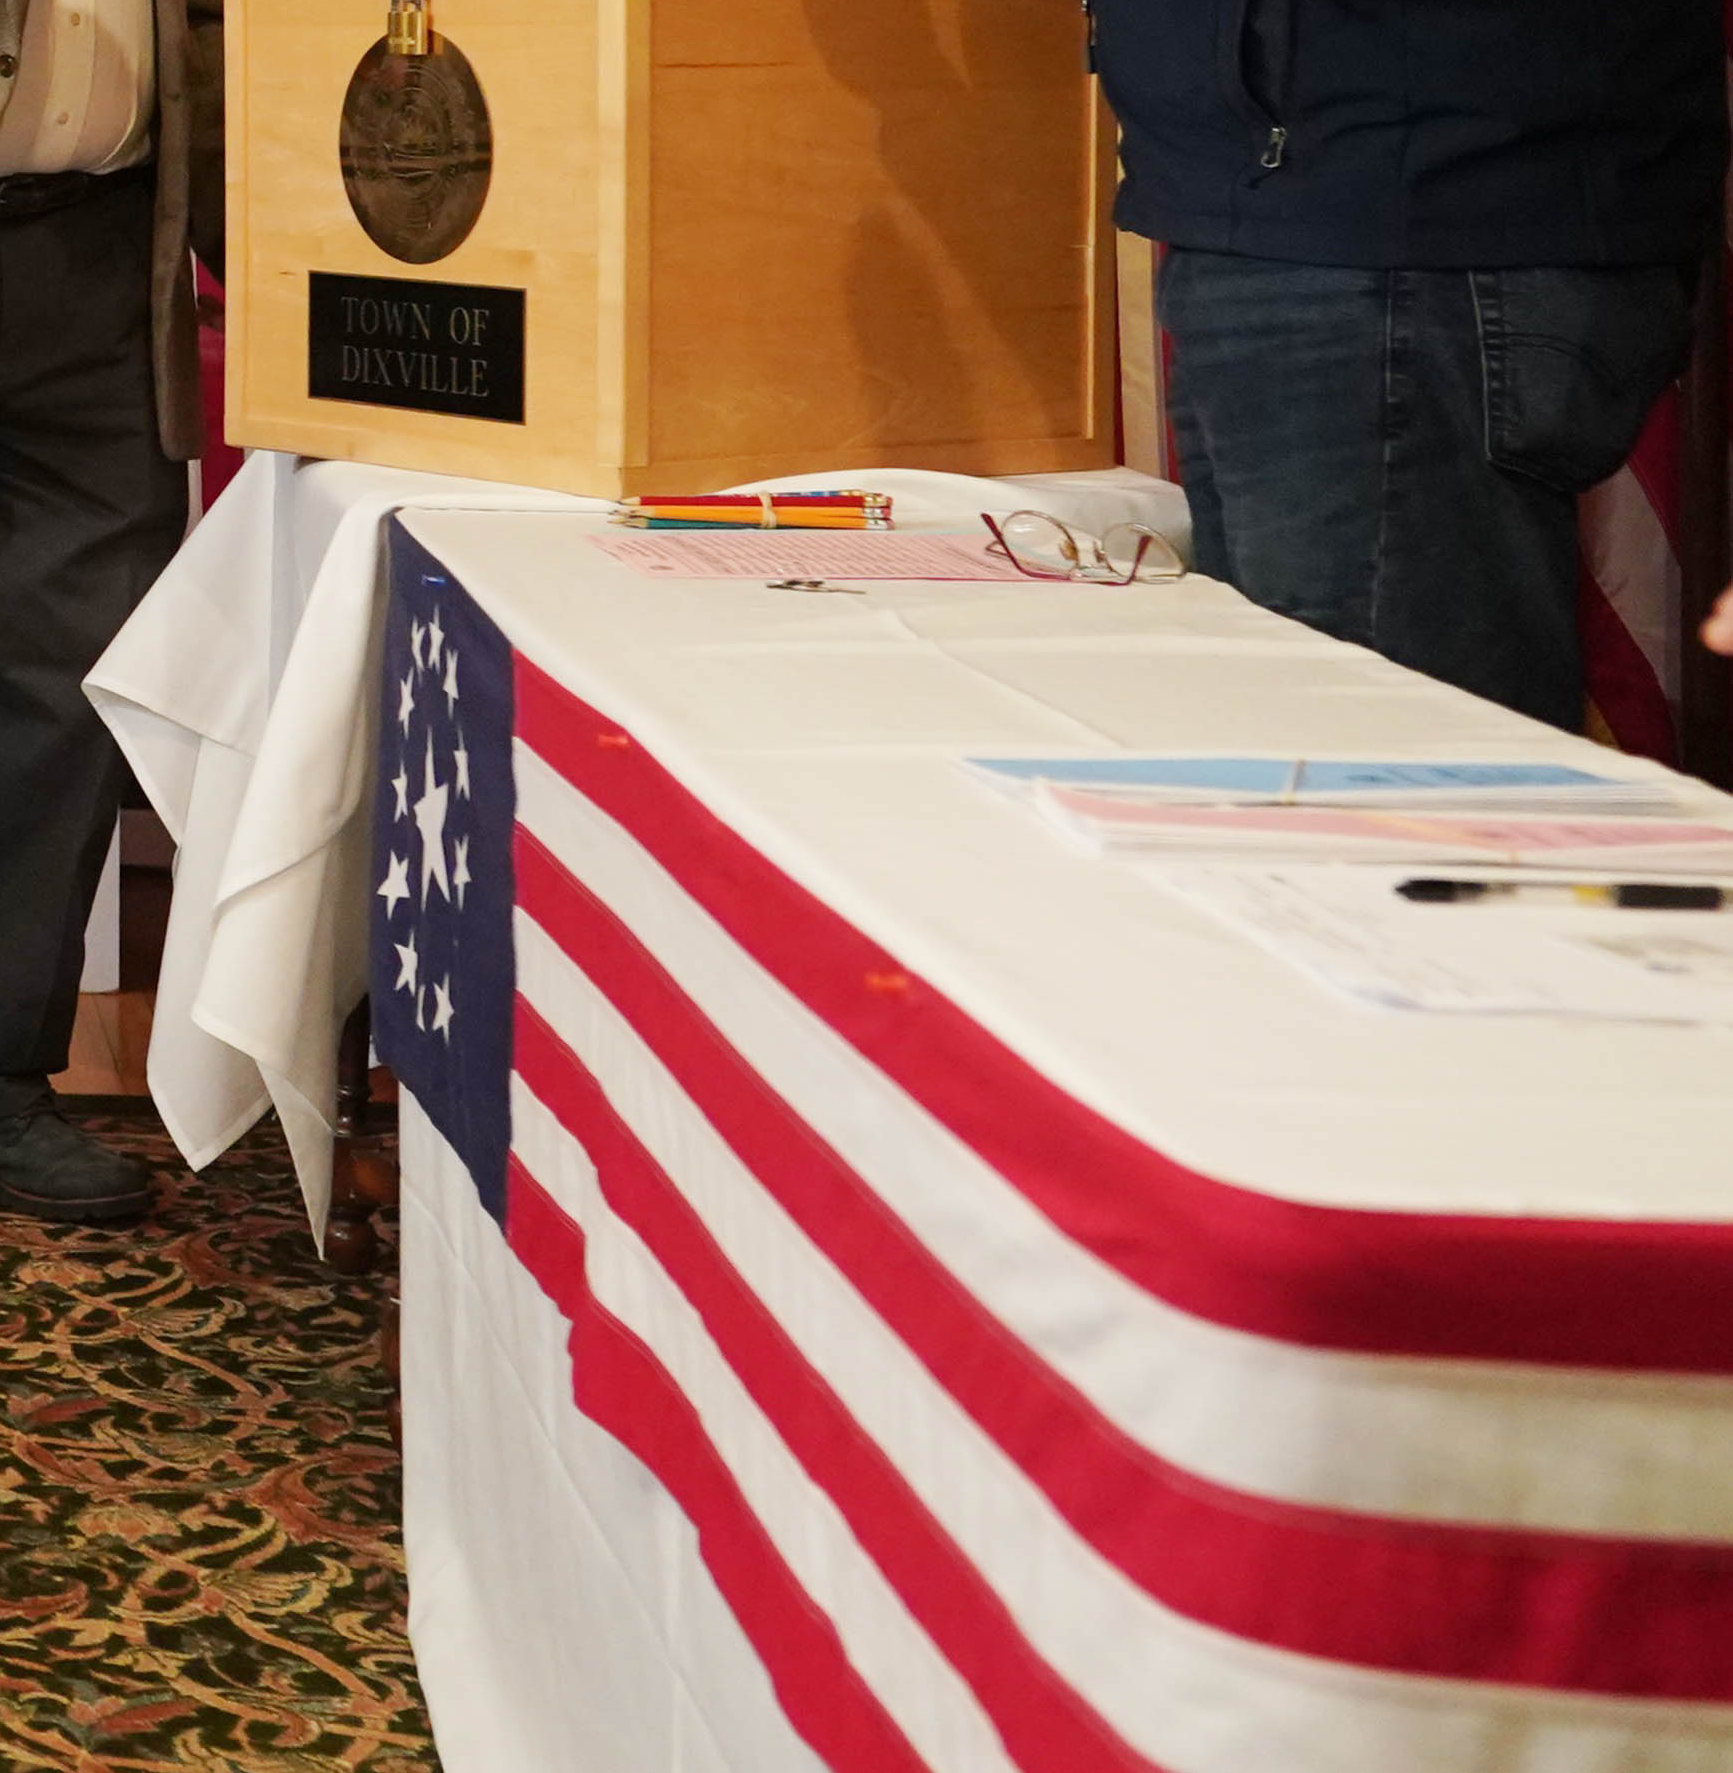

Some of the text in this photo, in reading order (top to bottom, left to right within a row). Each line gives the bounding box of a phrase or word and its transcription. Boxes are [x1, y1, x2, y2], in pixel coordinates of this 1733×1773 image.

[341, 295, 490, 347] TOWN OF
[341, 344, 490, 397] DIXVILLE
